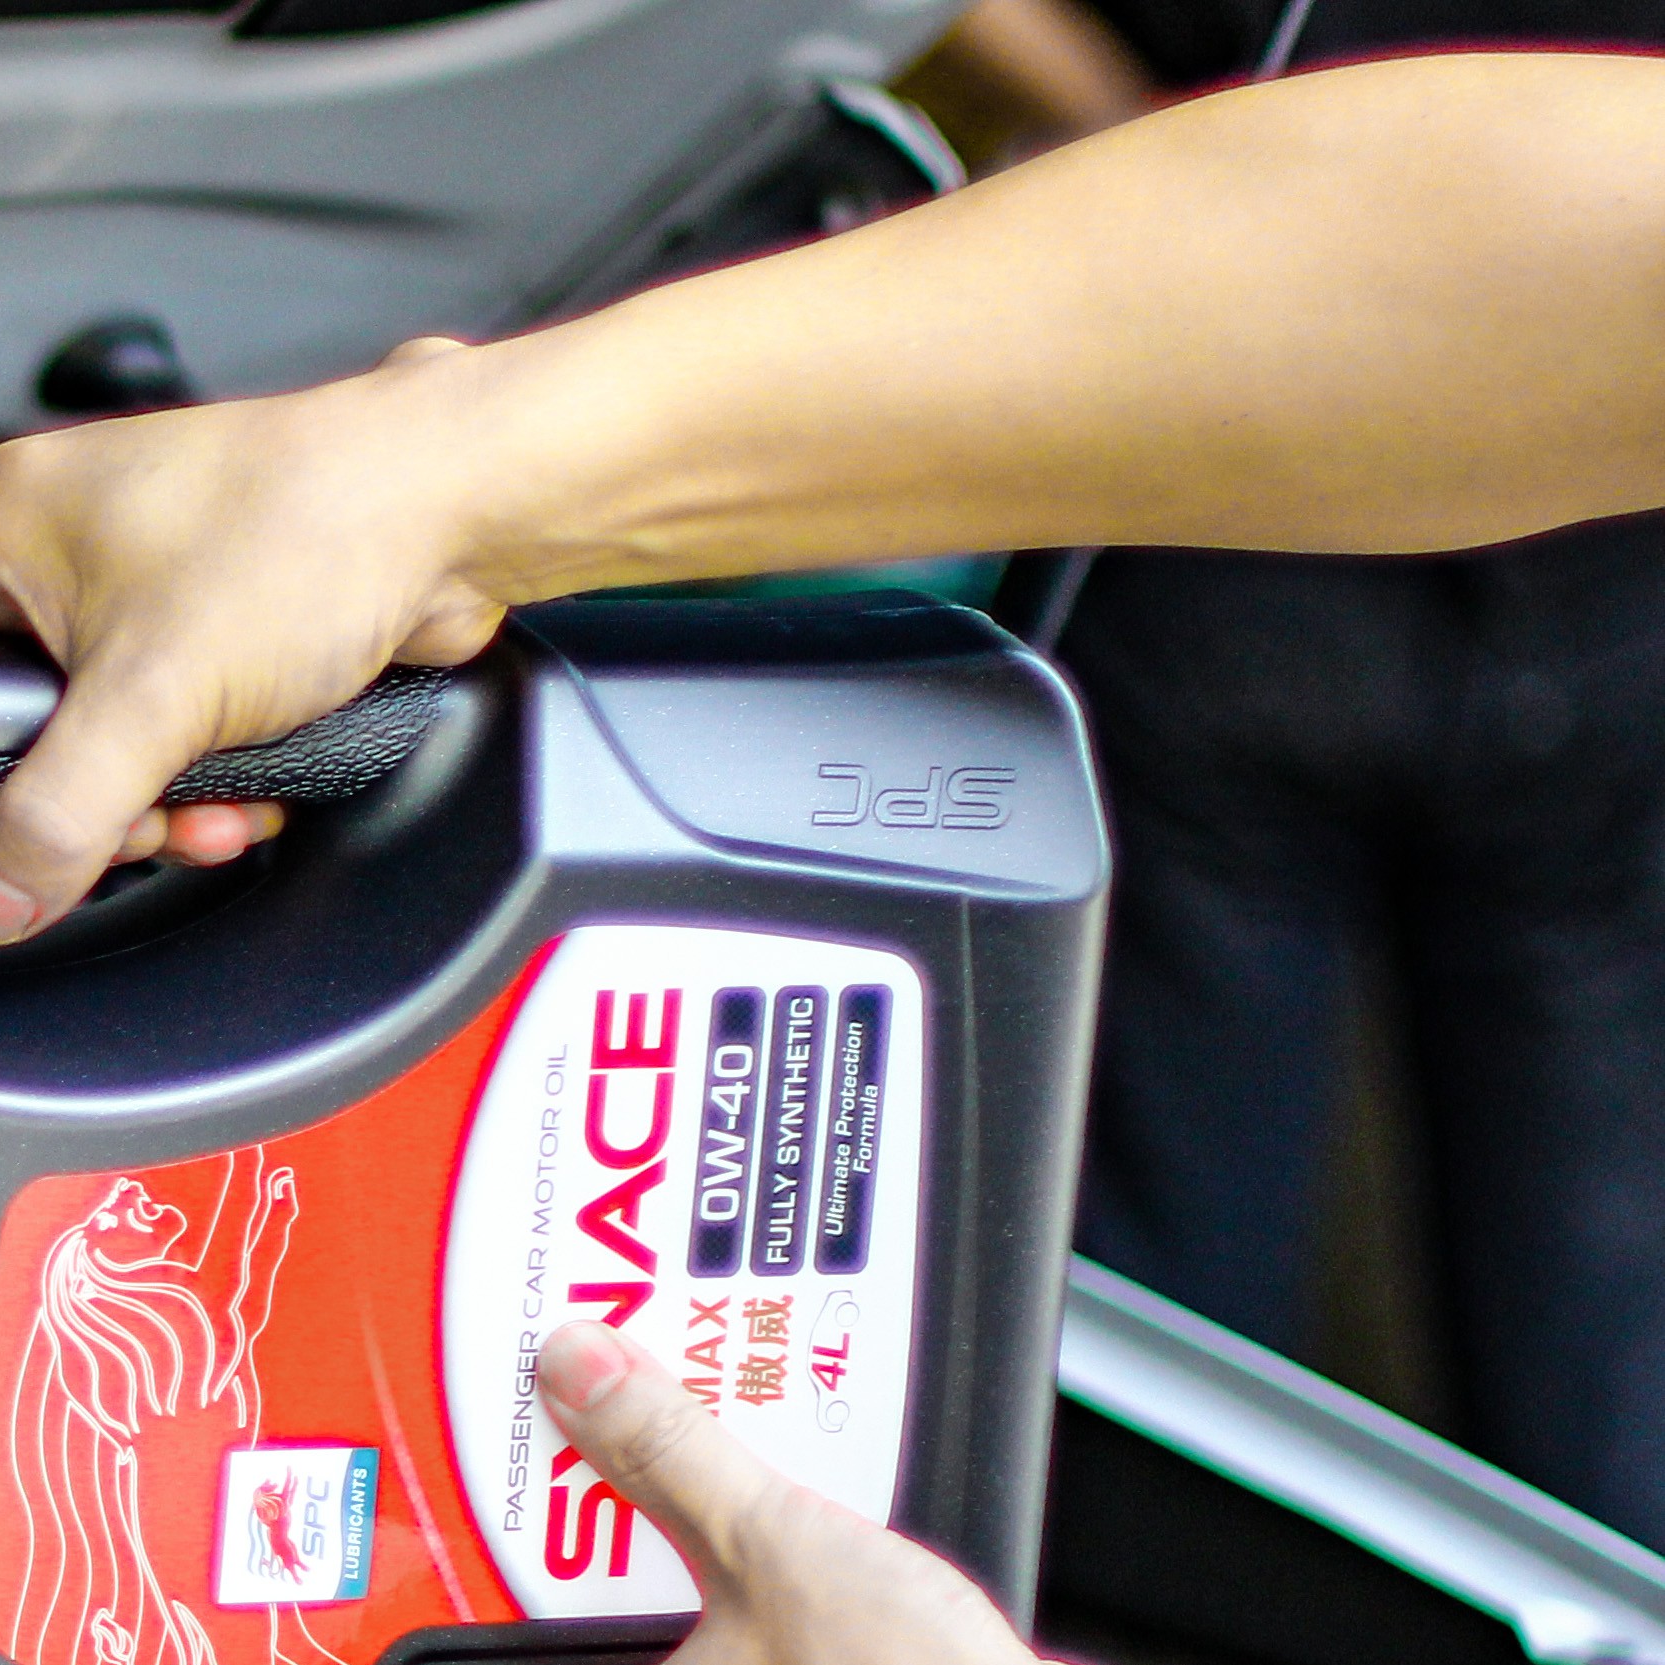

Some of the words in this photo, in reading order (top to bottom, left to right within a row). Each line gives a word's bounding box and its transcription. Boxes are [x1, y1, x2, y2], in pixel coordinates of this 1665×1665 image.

[811, 762, 1016, 831] SPC
[546, 1044, 570, 1097] OIL
[776, 995, 815, 1165] SYNTHETIC
[835, 1019, 865, 1119] Protection
[537, 1110, 563, 1237] MOTOR
[852, 1083, 879, 1175] Formula
[765, 1168, 797, 1263] FULLY
[824, 1123, 852, 1238] Ultimate
[521, 1247, 548, 1318] CAR
[735, 1294, 795, 1406] 傲威
[810, 1332, 852, 1393] 4L
[503, 1330, 541, 1532] PASSENGER
[301, 1475, 330, 1560] SPC
[344, 1467, 368, 1580] LUBRICANTS
